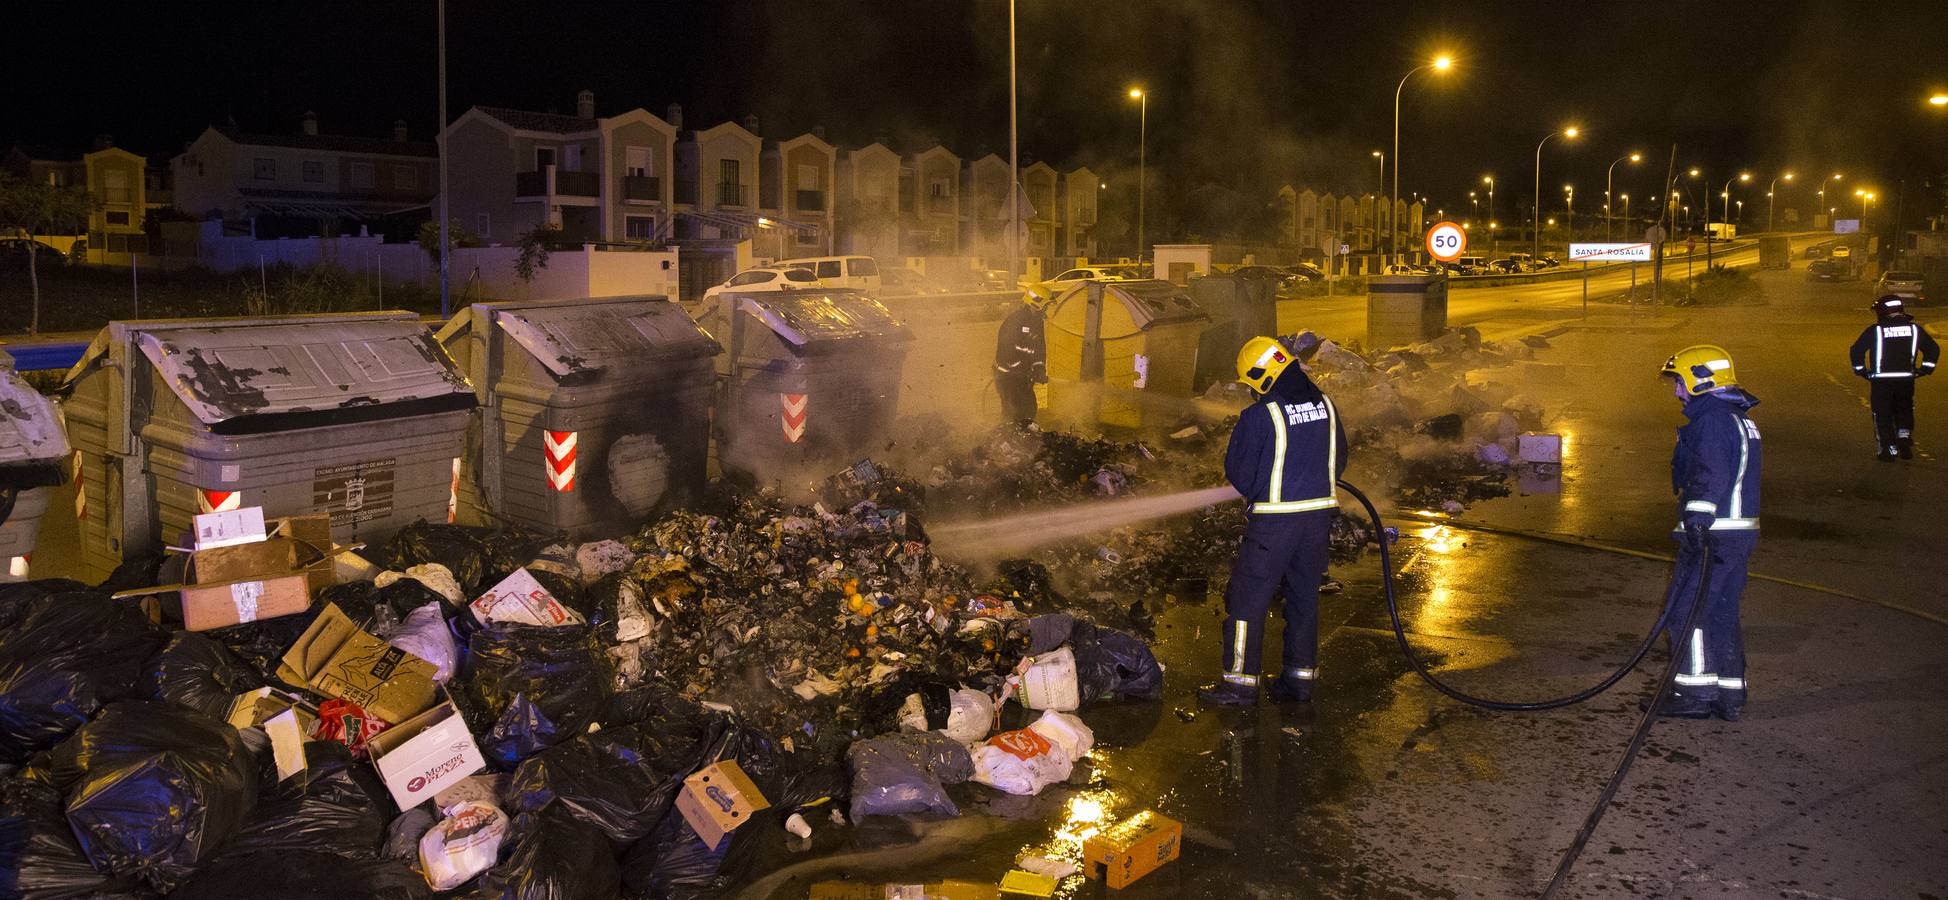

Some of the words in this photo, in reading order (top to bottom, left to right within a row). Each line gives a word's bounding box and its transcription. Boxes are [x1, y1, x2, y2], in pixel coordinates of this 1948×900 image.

[1435, 235, 1457, 248] 50
[1575, 248, 1603, 256] SANTA
[1284, 404, 1295, 415] RC
[1302, 411, 1310, 422] DE
[425, 753, 463, 779] Moreno
[427, 758, 466, 785] PLAZA
